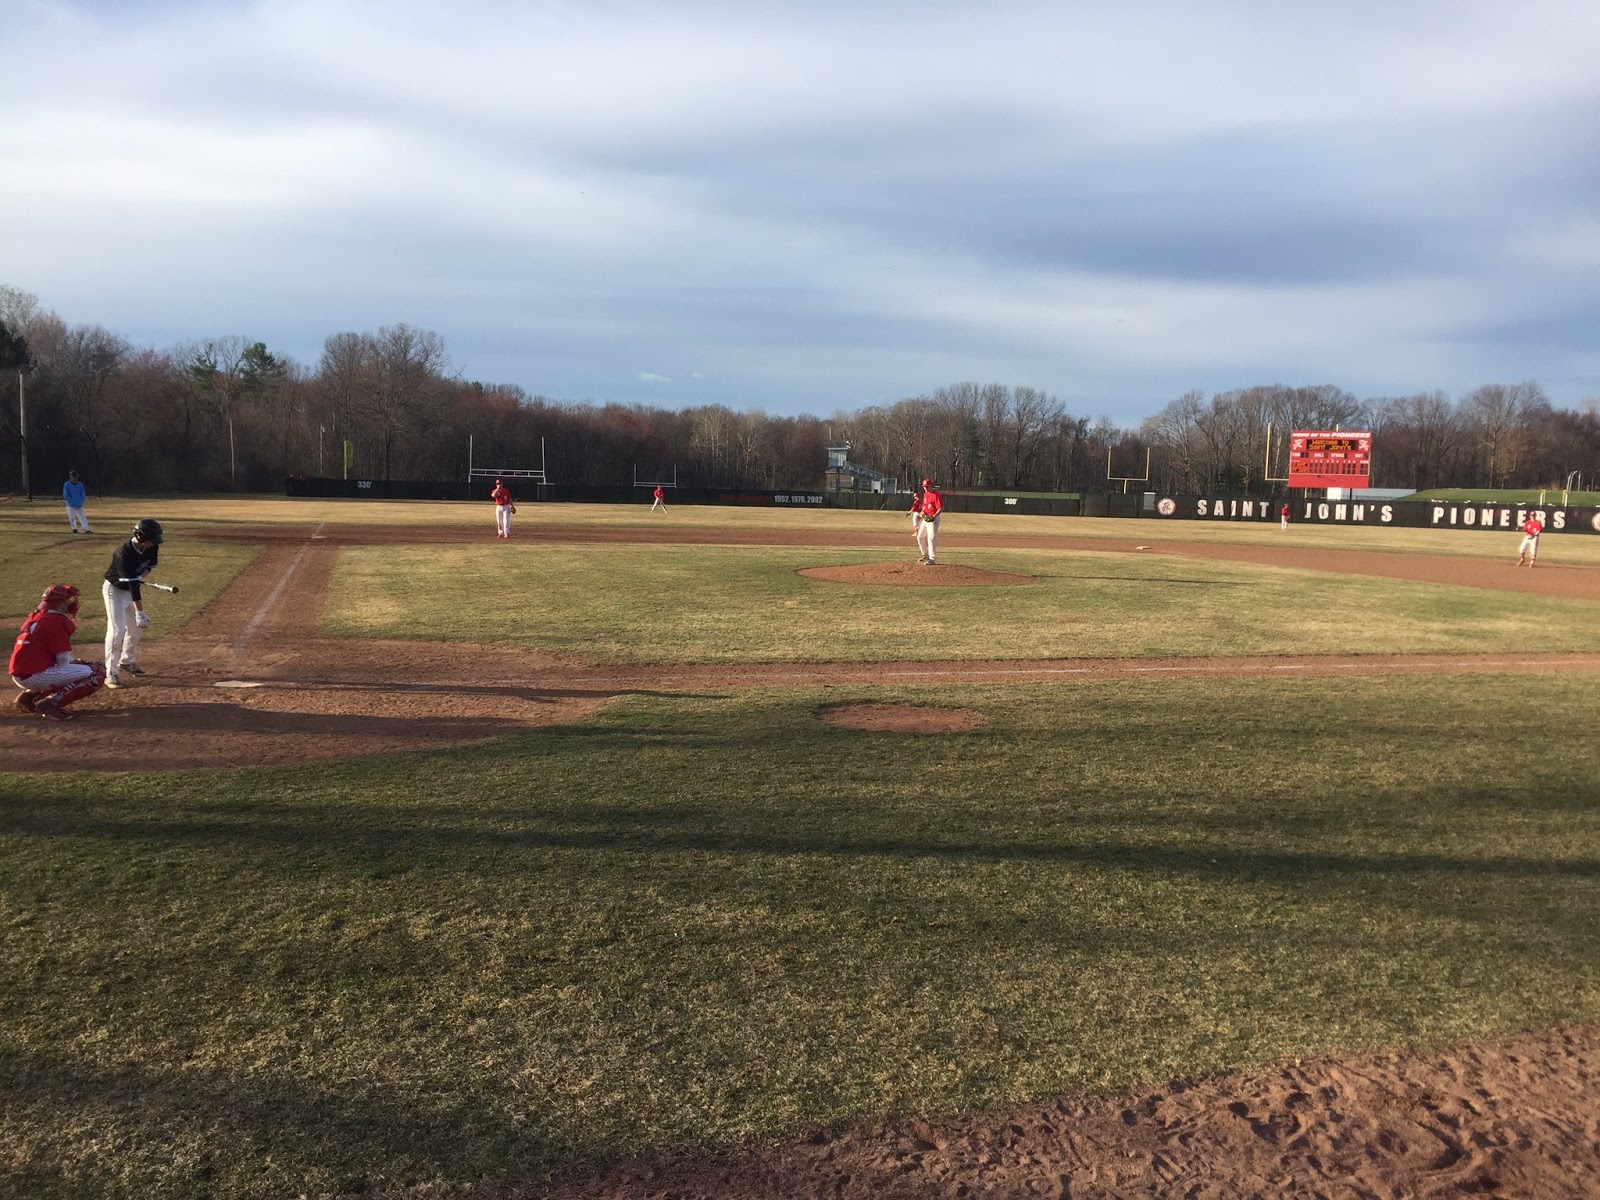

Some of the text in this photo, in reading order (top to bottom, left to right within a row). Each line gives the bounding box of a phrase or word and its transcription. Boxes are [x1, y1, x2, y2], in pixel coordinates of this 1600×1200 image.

[1197, 500, 1566, 528] SAINT JOHN'S PIONEERS
